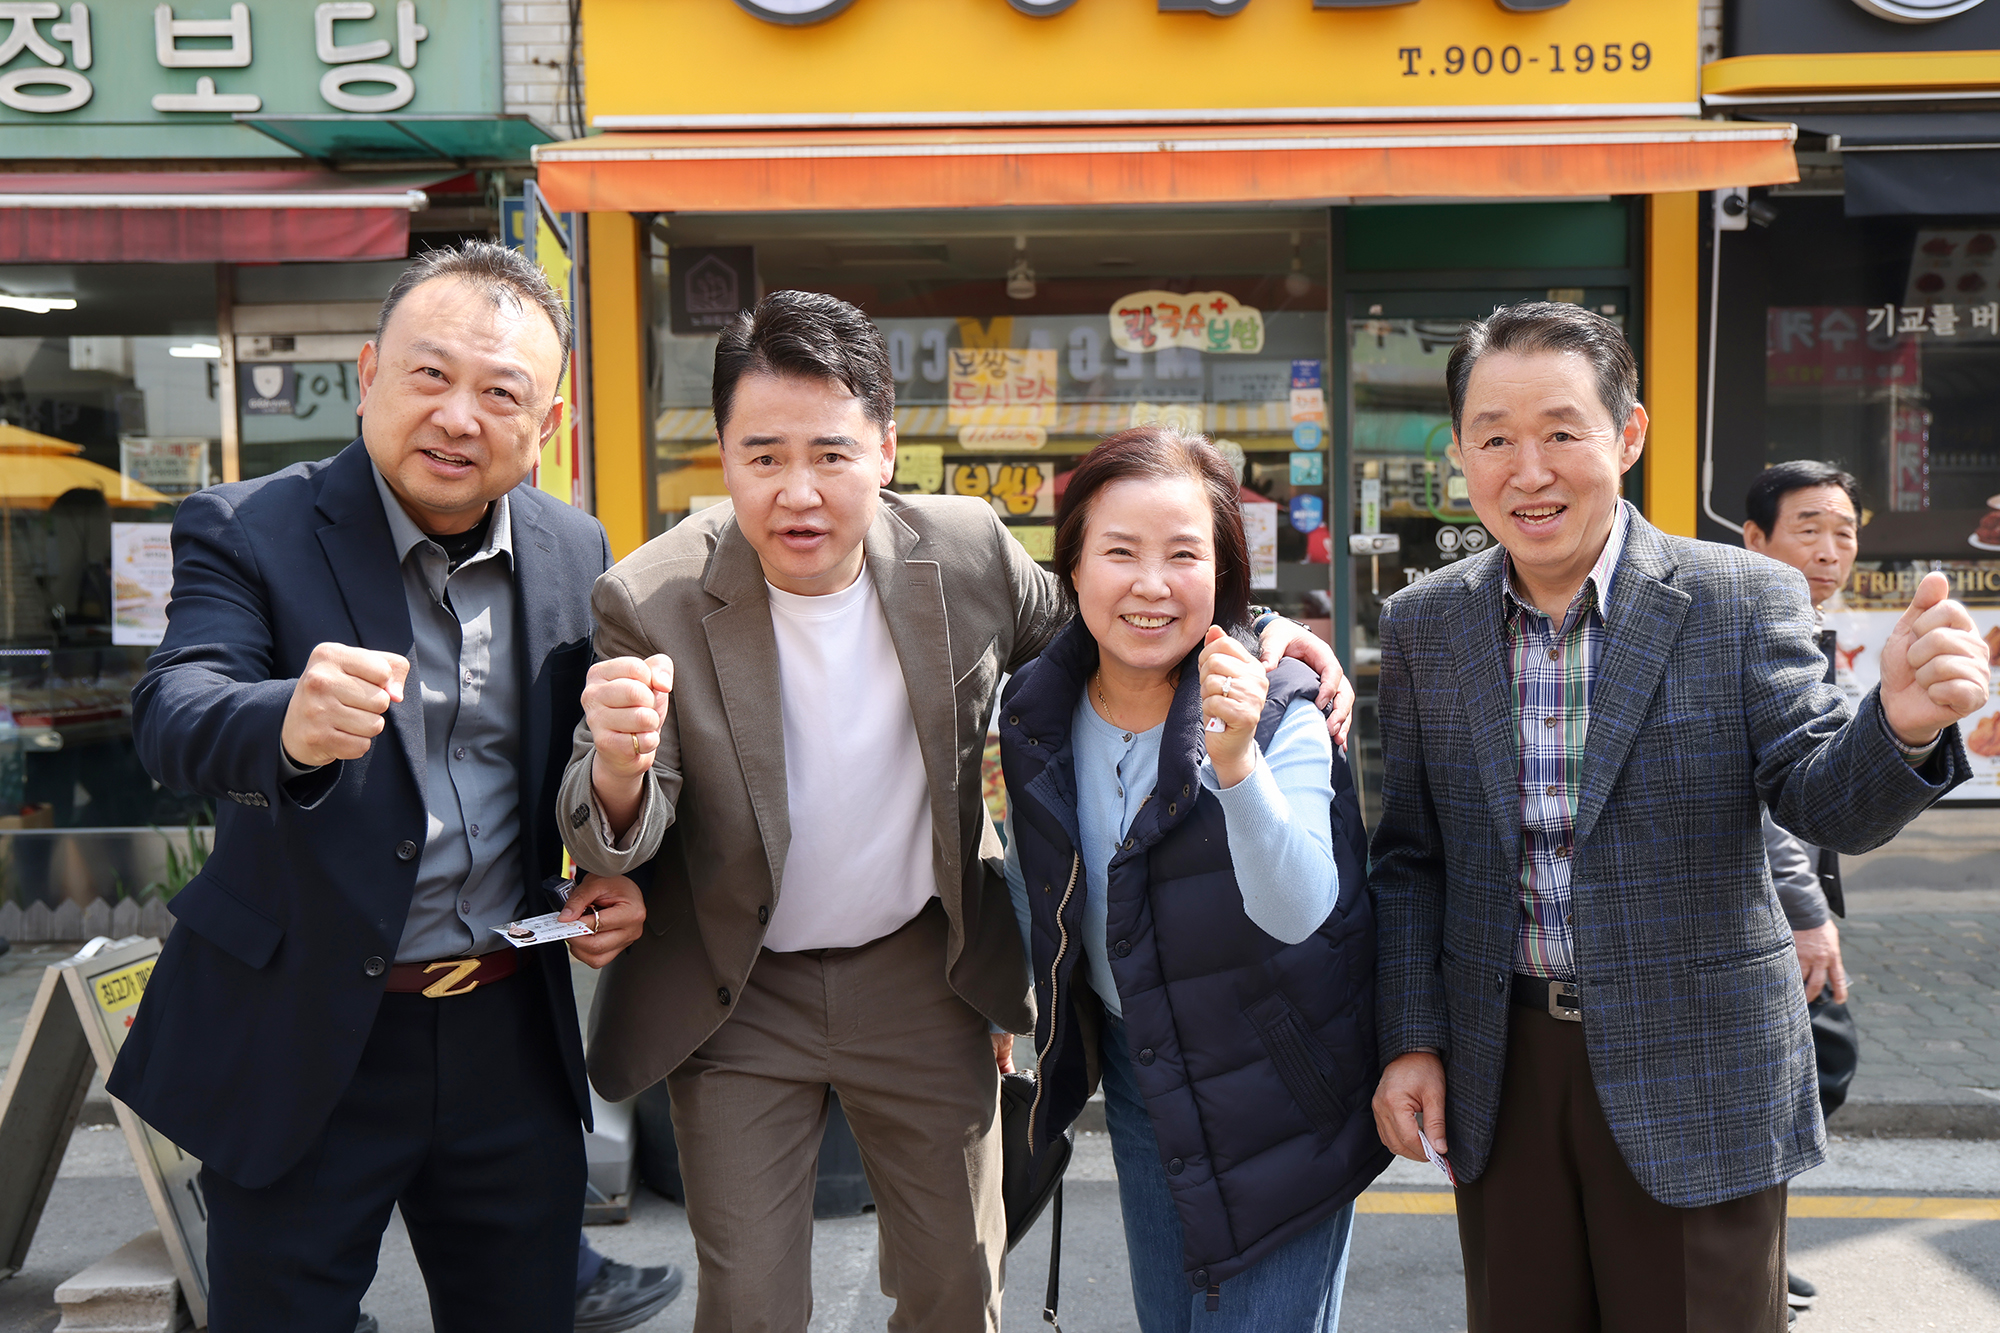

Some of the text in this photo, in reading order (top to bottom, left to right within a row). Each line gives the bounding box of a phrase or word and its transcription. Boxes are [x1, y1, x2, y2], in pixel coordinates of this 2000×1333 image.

[1398, 41, 1652, 76] T.900-1959
[1866, 302, 1960, 337] 기교를
[1970, 301, 1999, 336] 버
[949, 375, 1056, 420] 도시락
[100, 973, 138, 1006] 최고가
